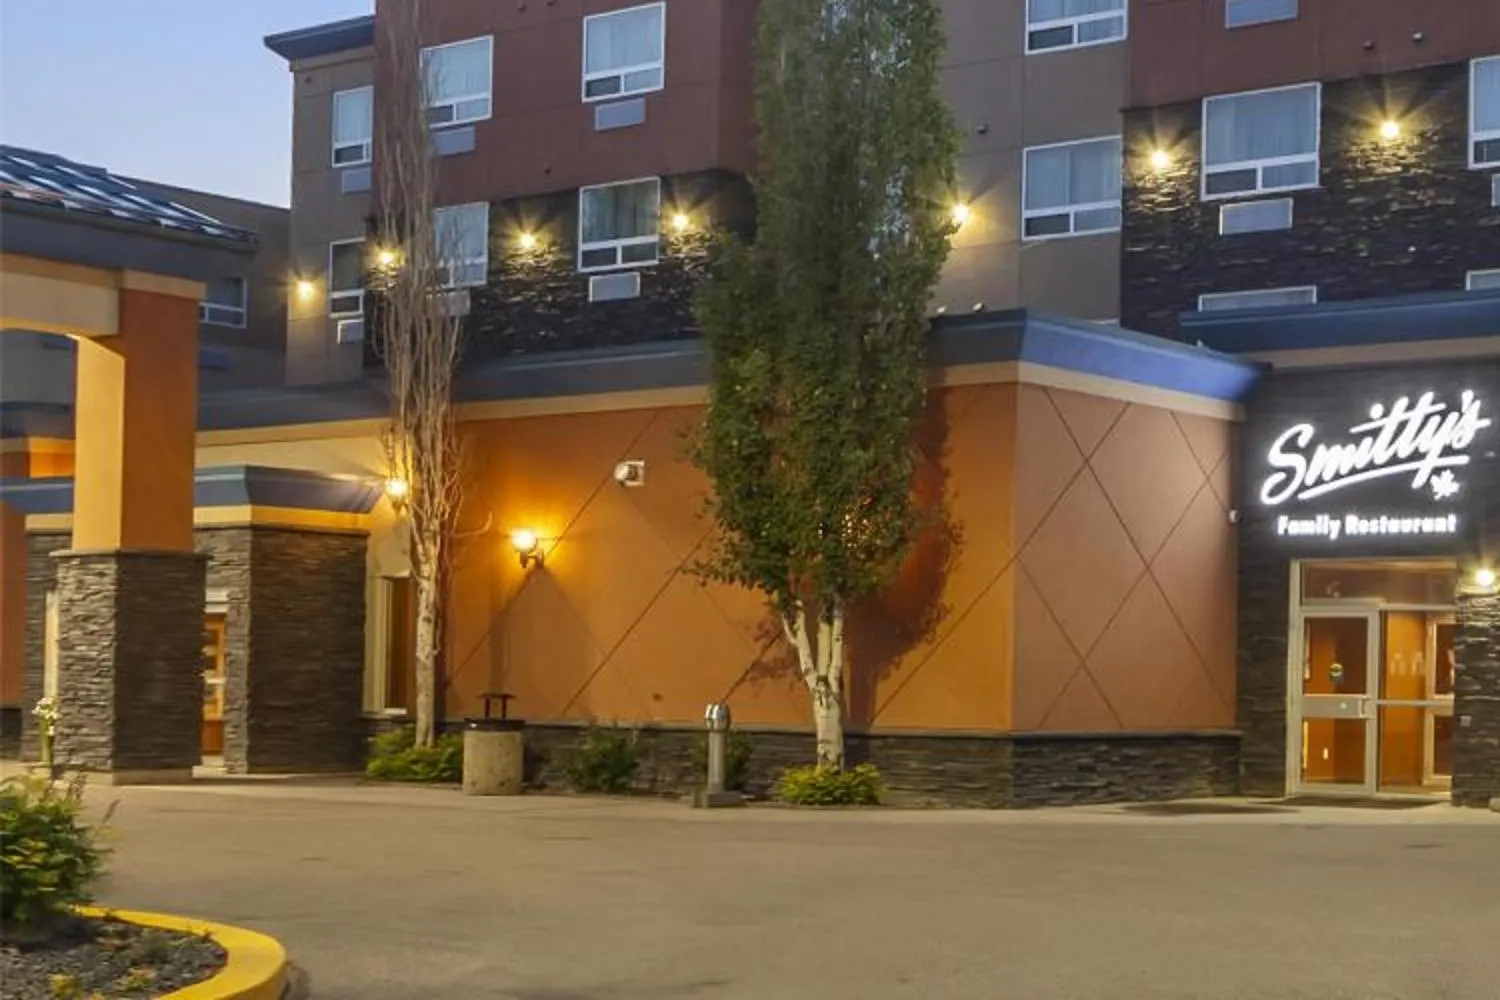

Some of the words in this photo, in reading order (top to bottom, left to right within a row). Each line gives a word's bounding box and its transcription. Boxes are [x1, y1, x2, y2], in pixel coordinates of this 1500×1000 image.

[1261, 389, 1492, 505] Smitty's
[1278, 513, 1341, 541] Family
[1345, 513, 1458, 534] Restaurant
